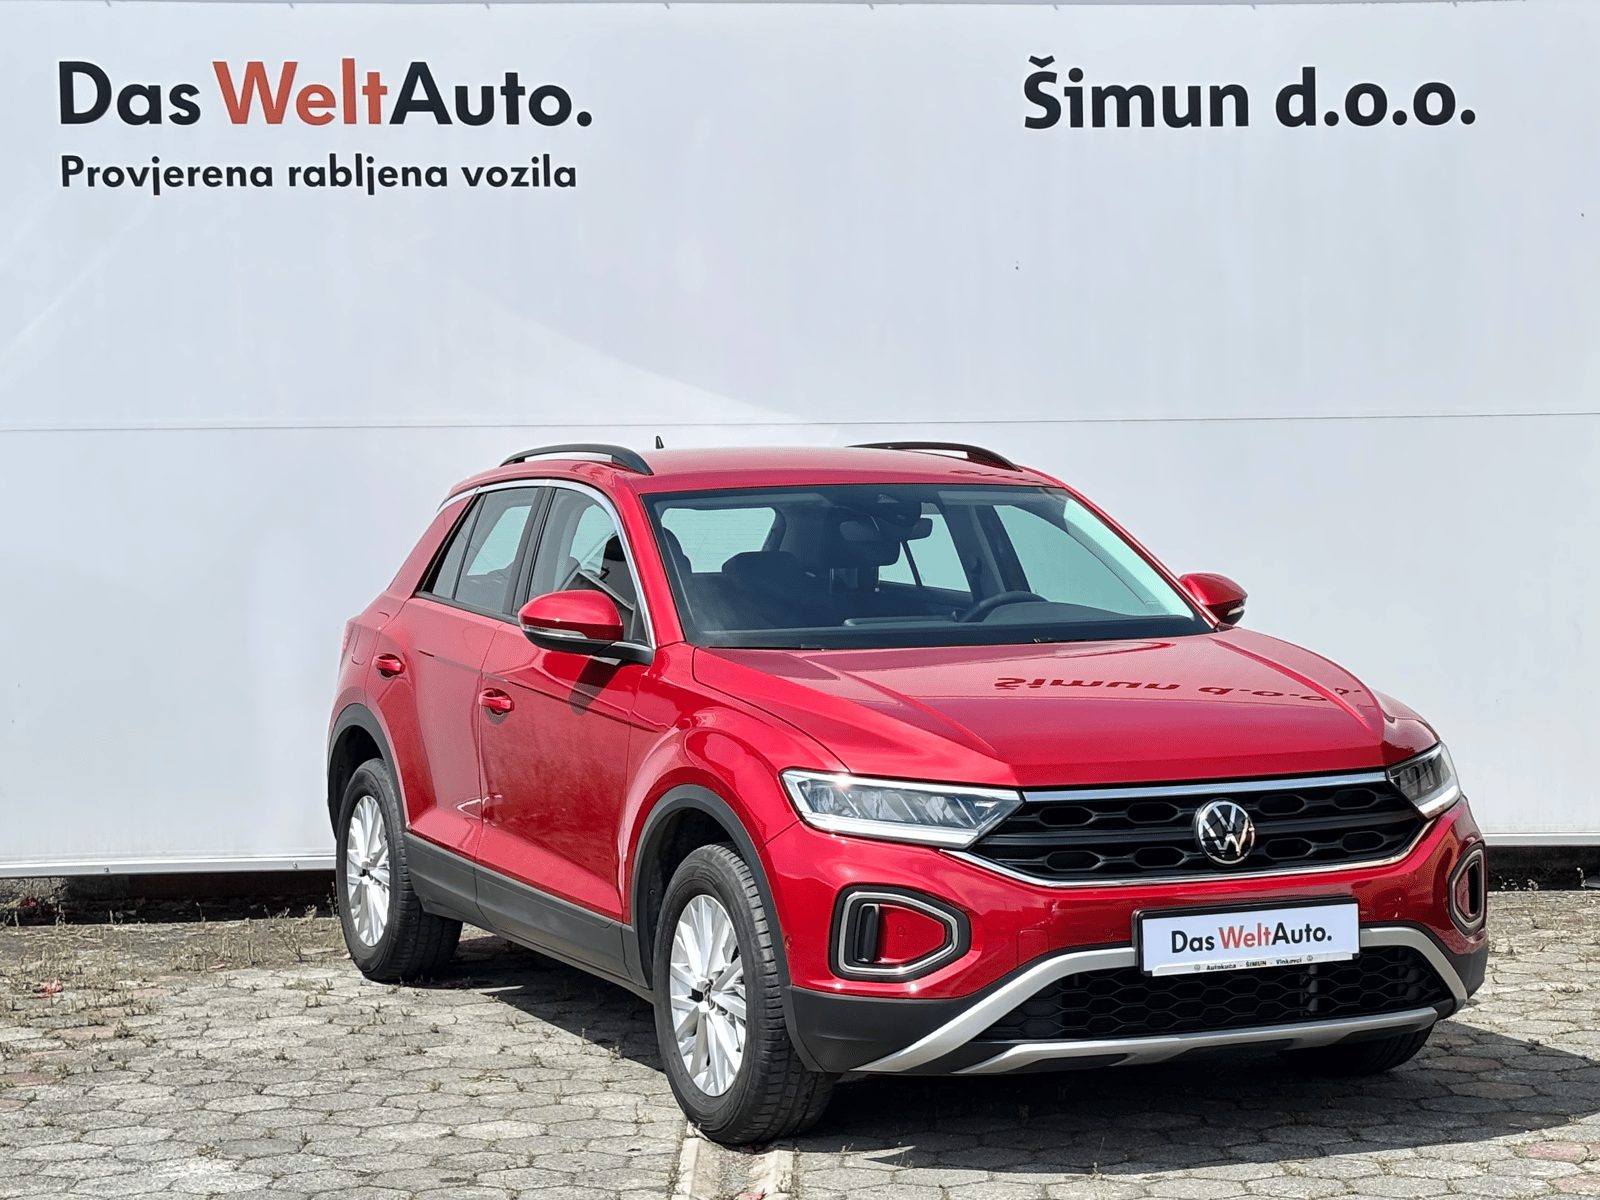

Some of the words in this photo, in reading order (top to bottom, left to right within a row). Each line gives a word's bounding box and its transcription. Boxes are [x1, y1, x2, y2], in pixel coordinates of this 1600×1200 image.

[58, 60, 201, 126] Das
[212, 58, 593, 128] WeltAuto.
[1023, 55, 1249, 130] Šimun
[1275, 66, 1476, 128] d.o.o.
[61, 154, 273, 196] Provjerena
[288, 152, 448, 196] rabljena
[460, 153, 577, 188] vozila
[1199, 801, 1255, 864] VW
[1171, 930, 1216, 954] Das
[1218, 922, 1333, 949] WeltAuto.
